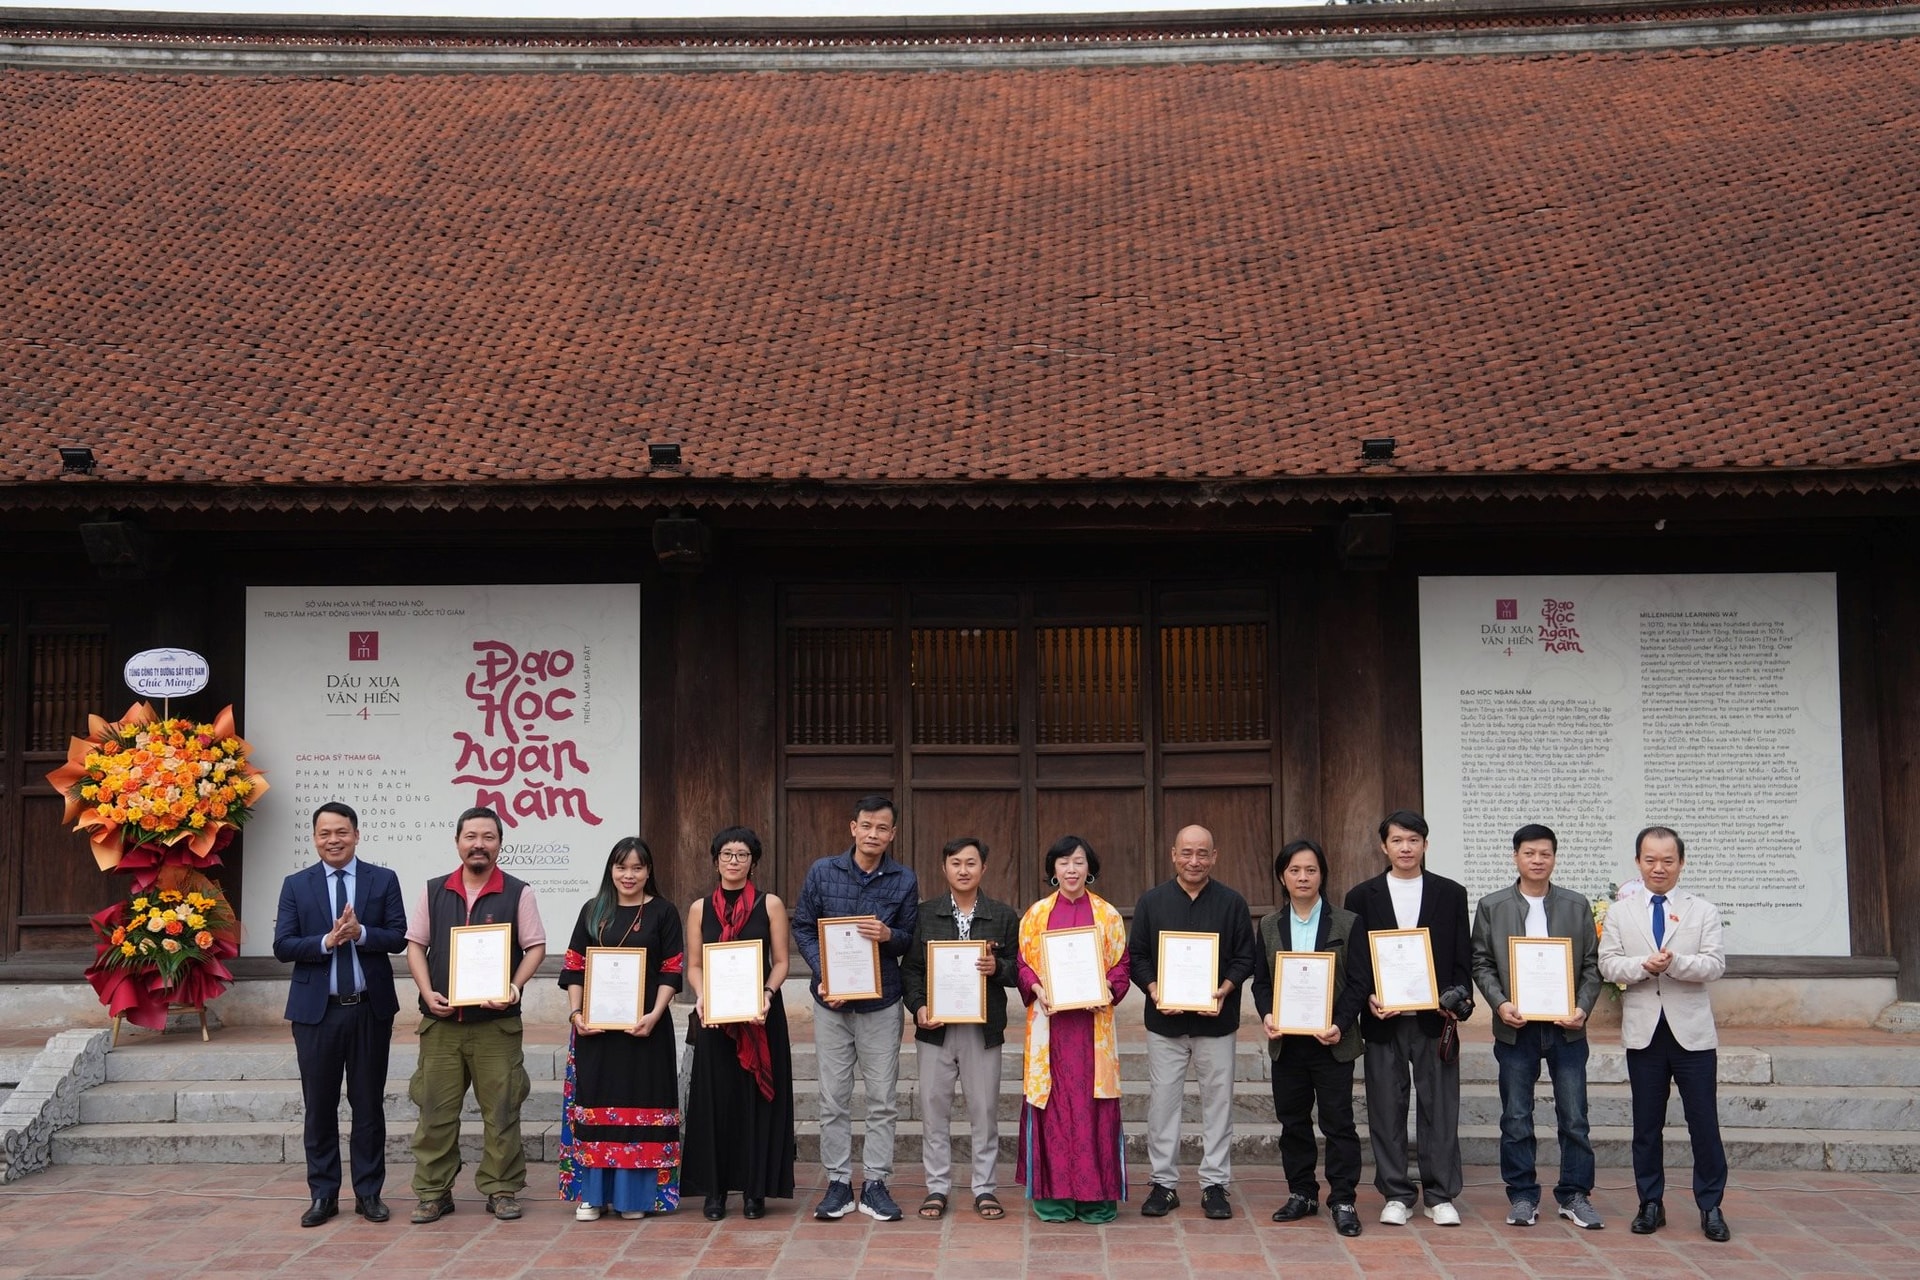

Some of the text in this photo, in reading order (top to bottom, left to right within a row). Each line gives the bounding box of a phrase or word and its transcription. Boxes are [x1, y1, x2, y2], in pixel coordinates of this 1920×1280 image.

[1543, 599, 1574, 612] Đạo
[1542, 609, 1575, 629] Học
[1481, 624, 1506, 634] DẤU
[1482, 635, 1534, 645] VĂN HIẾN
[1545, 640, 1584, 653] năm
[1503, 647, 1513, 656] 4
[473, 640, 574, 690] Đạo
[138, 678, 196, 688] Chúc Mừng!
[327, 673, 400, 688] DẤU XƯA
[327, 689, 400, 703] VĂN HIẾN
[356, 706, 370, 720] 4
[466, 672, 576, 744] Học
[476, 778, 603, 828] năm
[1736, 901, 1772, 910] respectfully
[1774, 901, 1802, 909] presents
